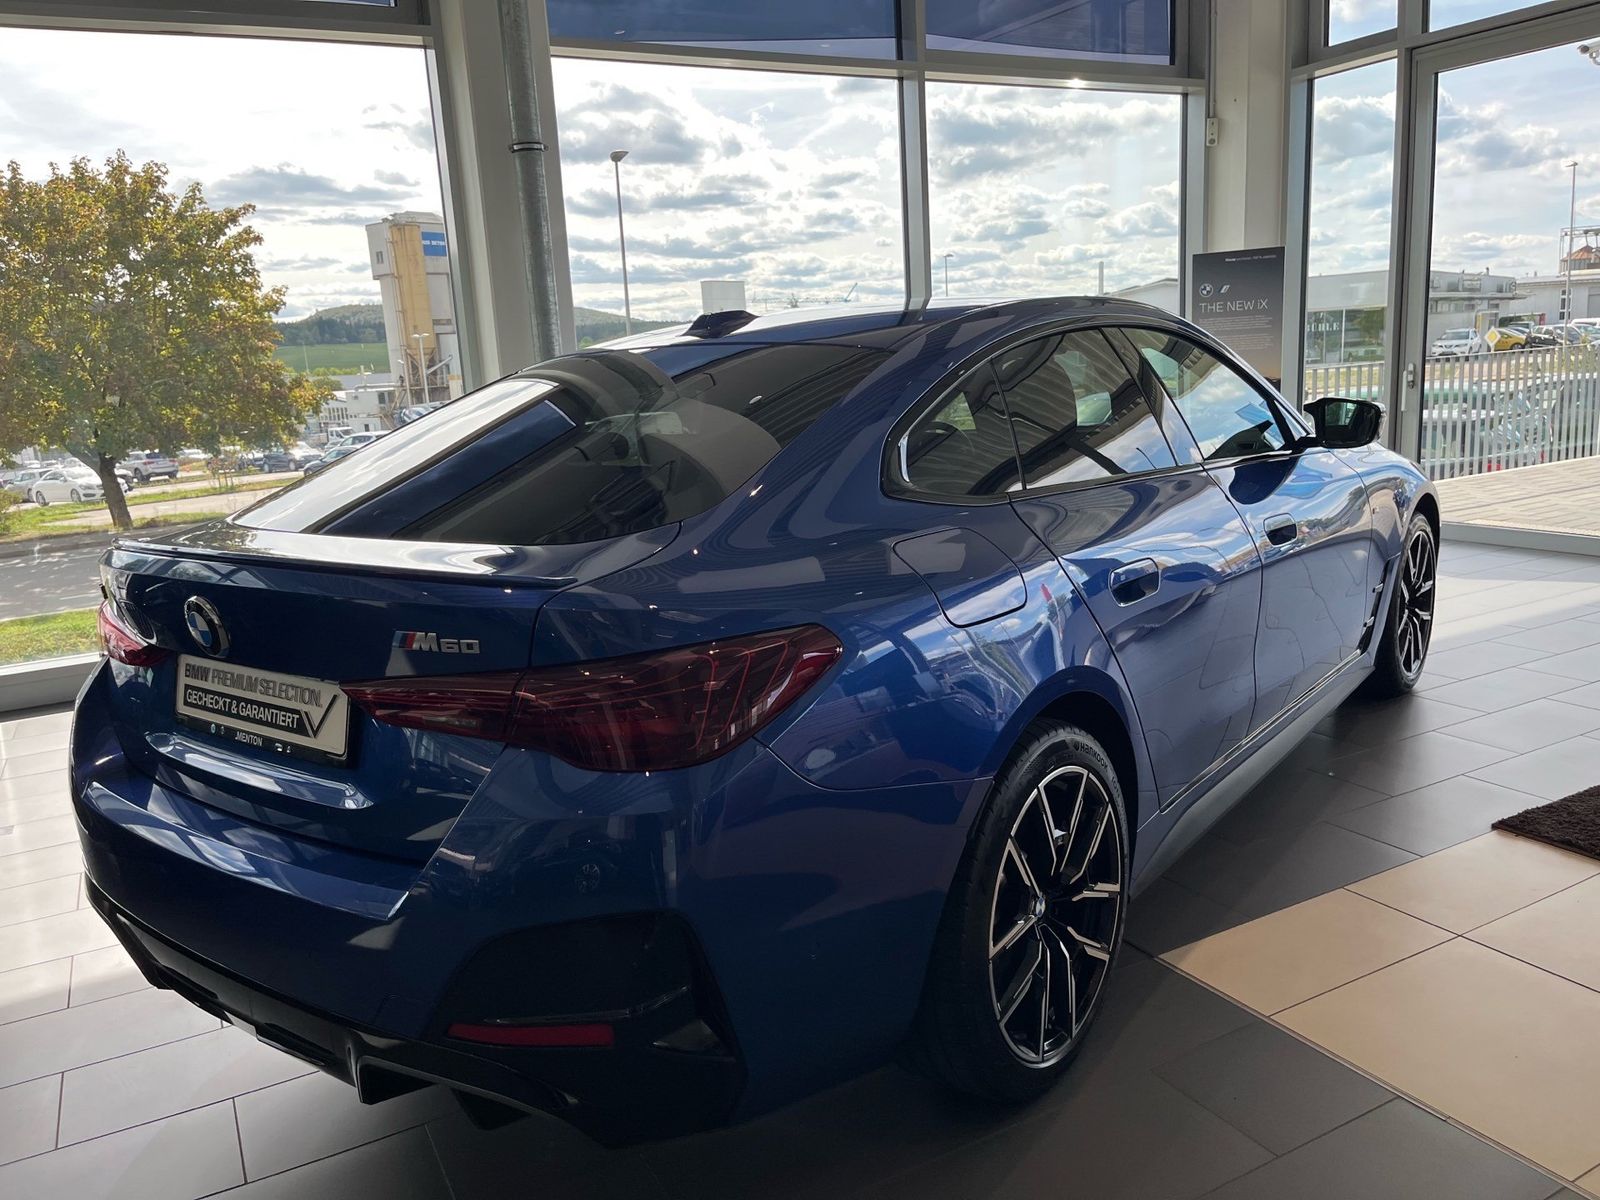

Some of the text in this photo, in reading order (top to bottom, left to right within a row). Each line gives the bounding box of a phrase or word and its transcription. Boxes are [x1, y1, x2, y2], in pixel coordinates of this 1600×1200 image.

[1199, 299, 1269, 313] THE NEW iX
[412, 631, 481, 654] M60
[184, 662, 211, 683] BMW
[211, 669, 258, 692] PREMIUM
[186, 689, 300, 729] GECHECKT & GARANTIERT
